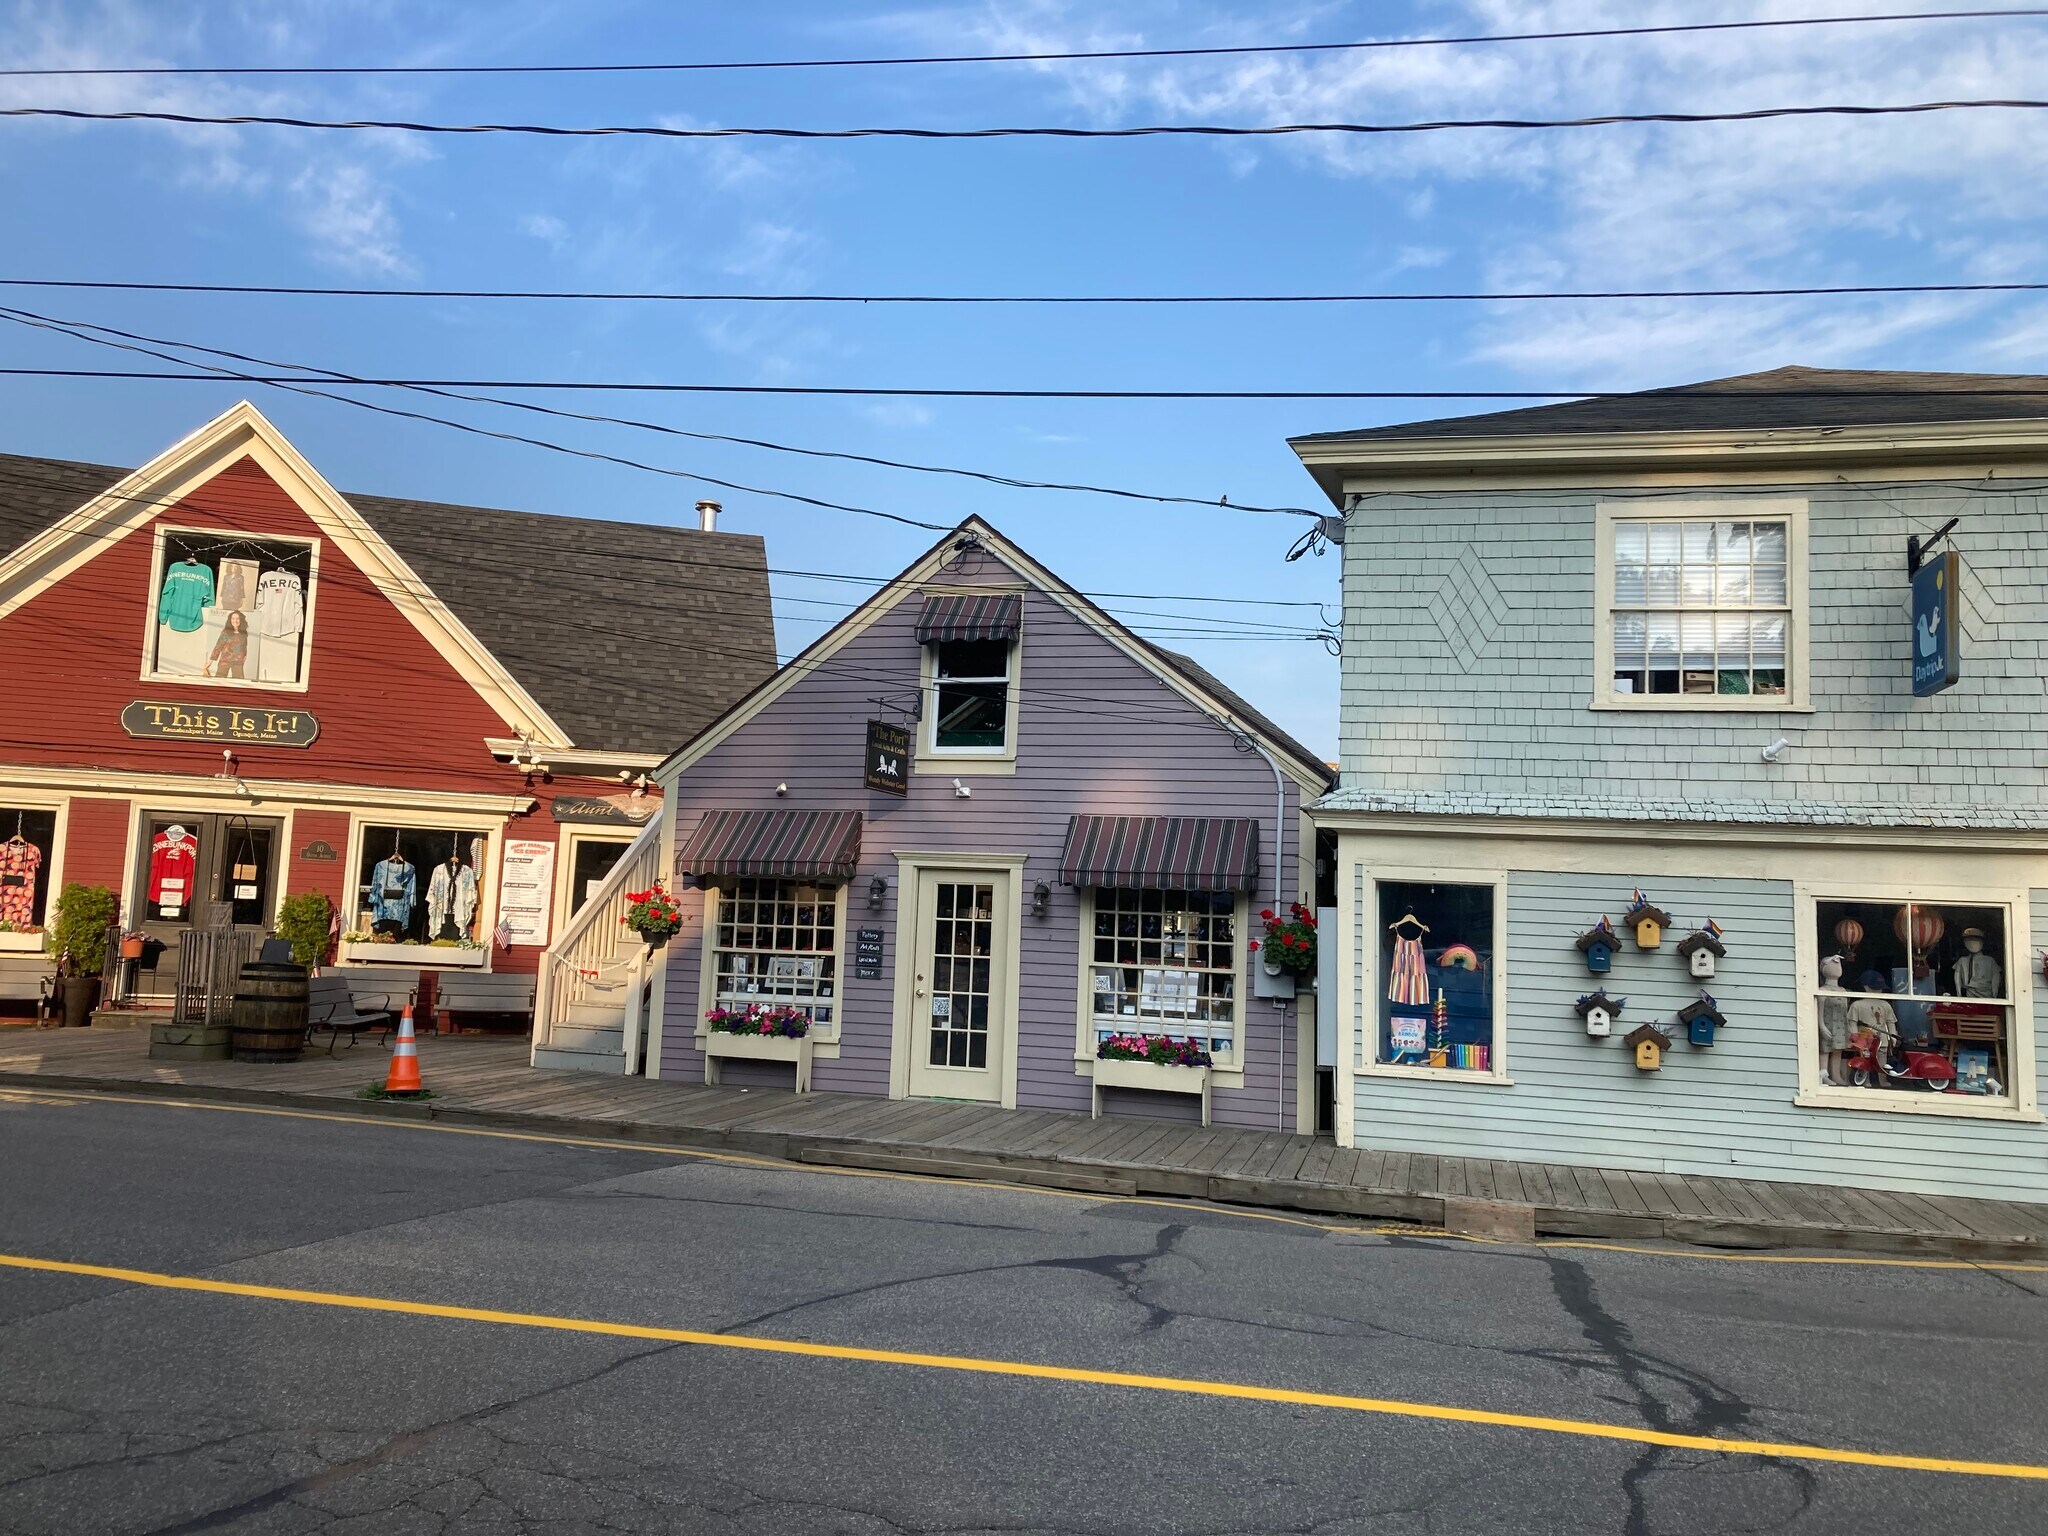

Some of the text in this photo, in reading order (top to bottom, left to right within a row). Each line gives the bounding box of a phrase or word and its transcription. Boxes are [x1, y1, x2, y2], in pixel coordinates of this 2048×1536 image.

[143, 705, 298, 733] This Is It!
[565, 801, 614, 817] Aunt
[316, 845, 325, 853] 10
